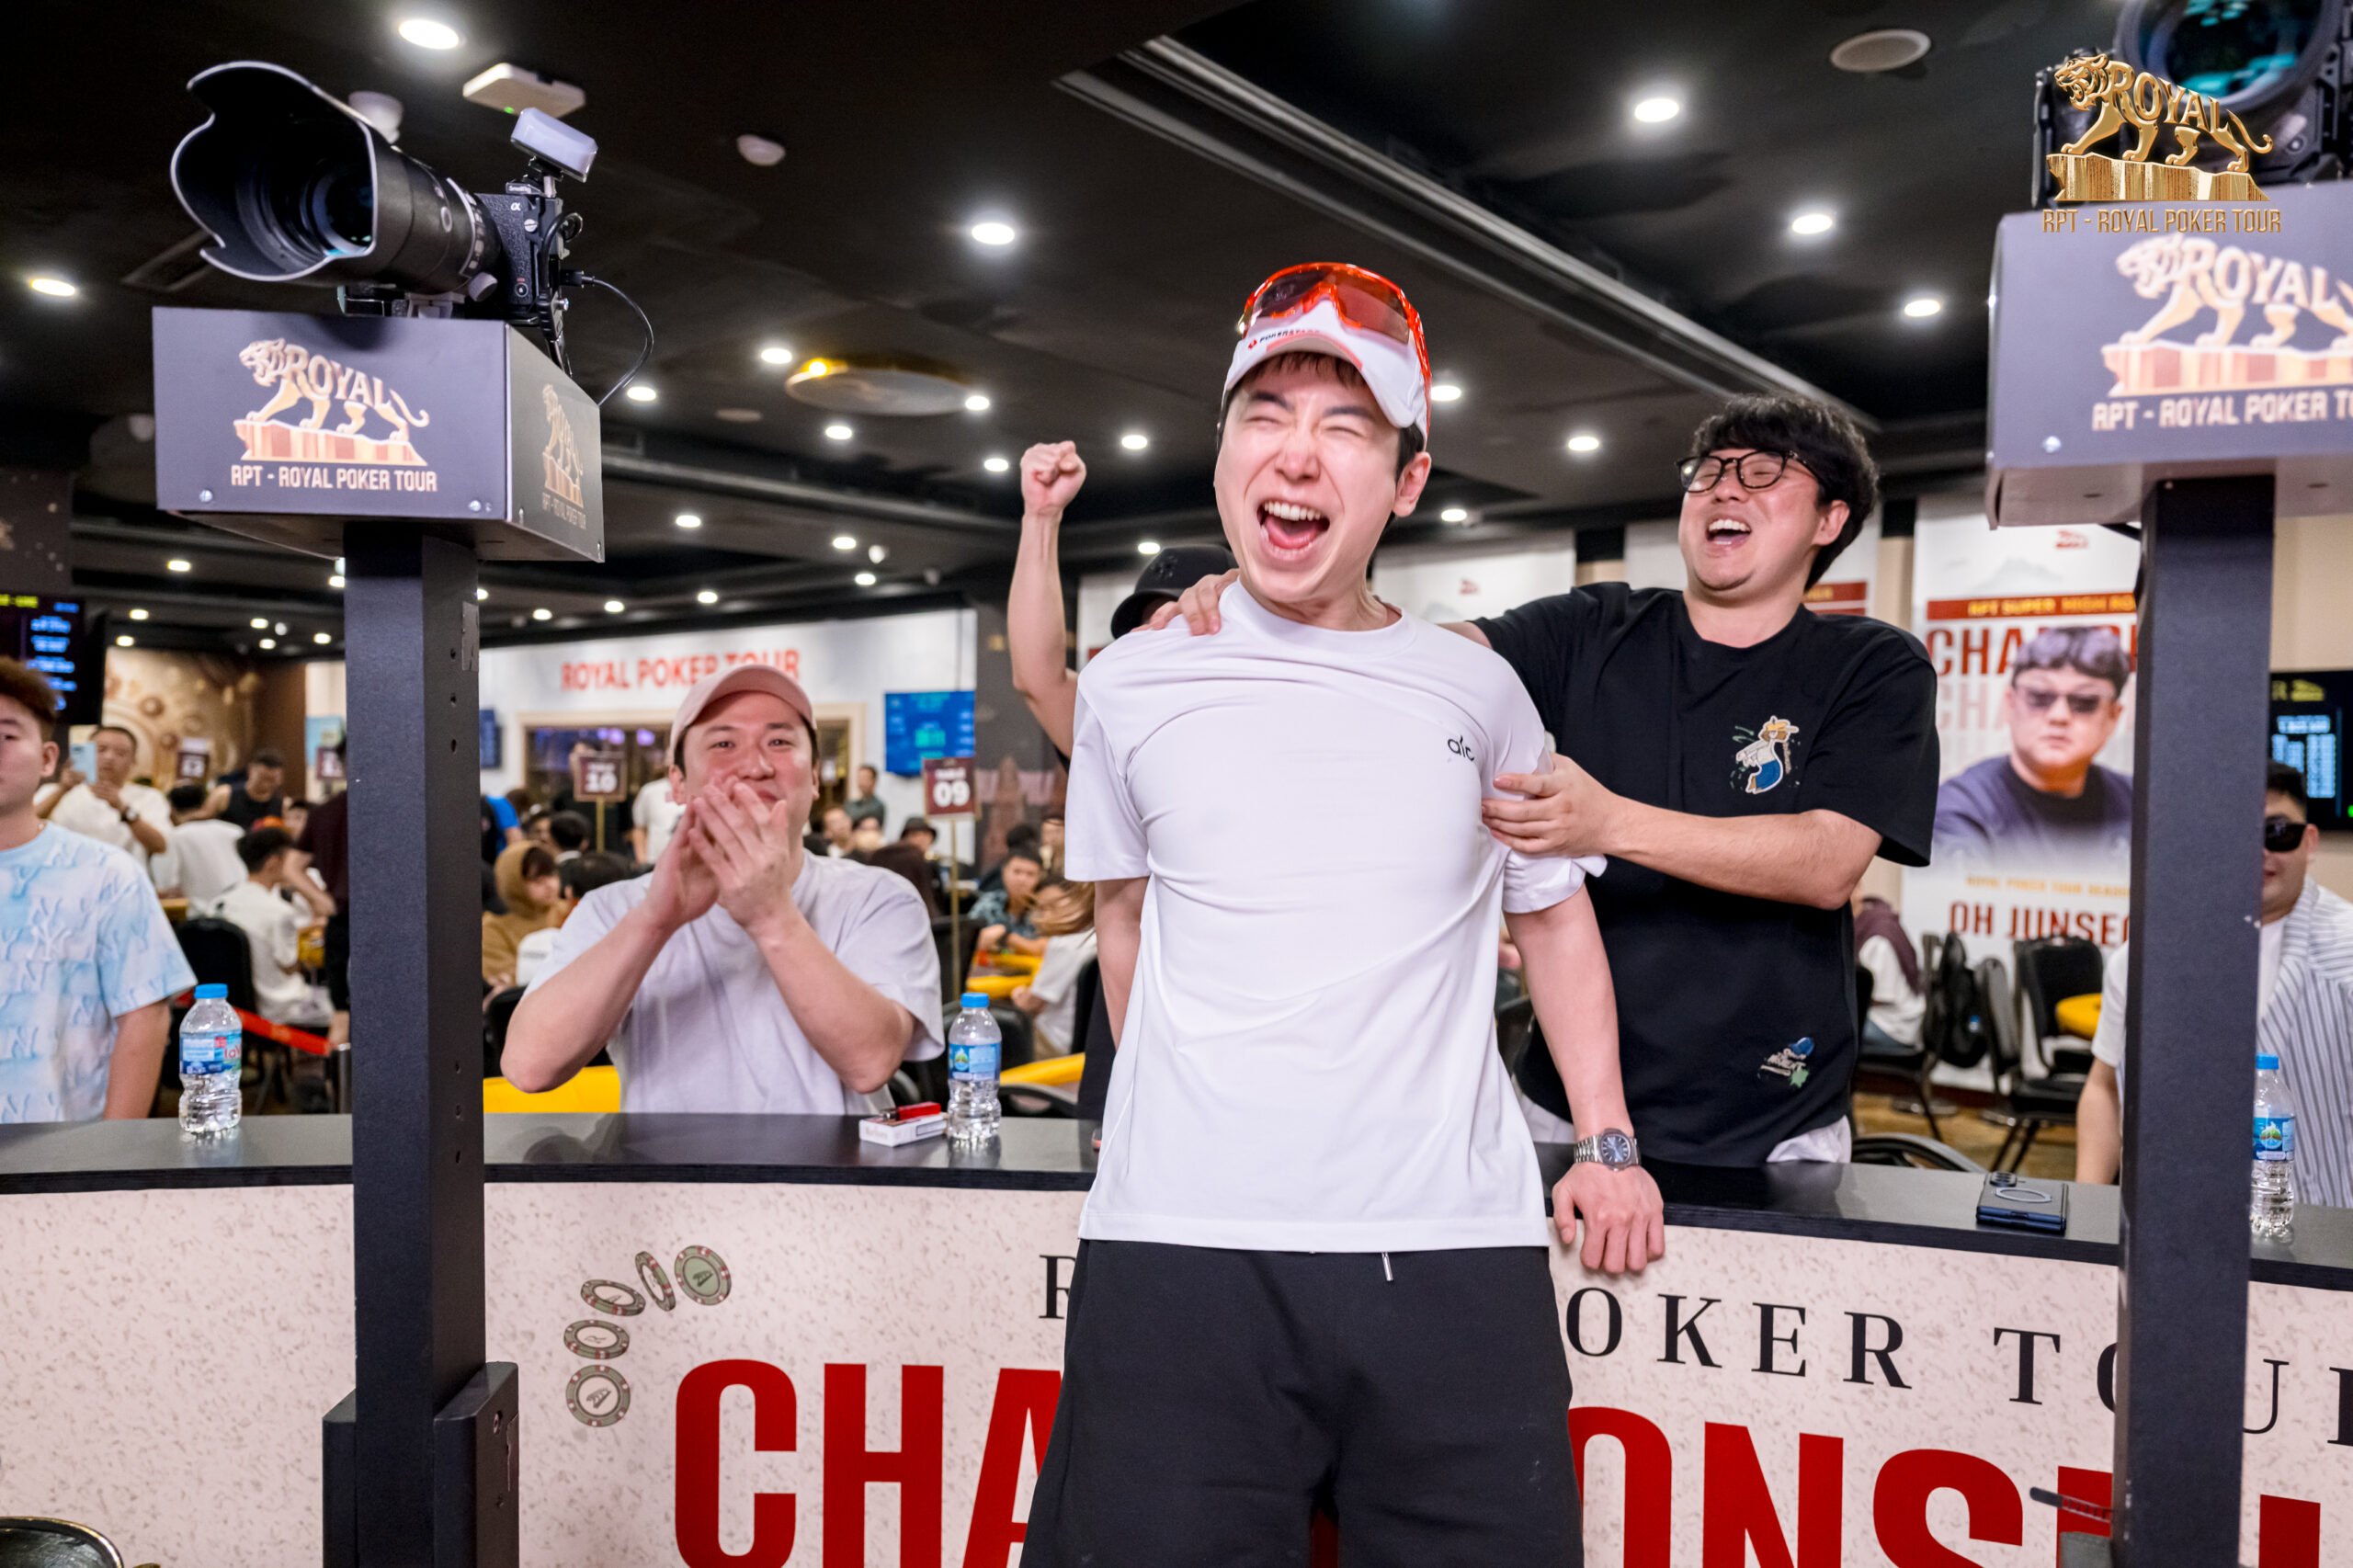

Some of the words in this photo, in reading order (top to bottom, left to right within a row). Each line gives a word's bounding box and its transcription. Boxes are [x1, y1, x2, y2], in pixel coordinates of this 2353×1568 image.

[2180, 237, 2338, 310] ROYAL
[284, 344, 392, 410] ROYAL
[2092, 402, 2139, 431] RPT
[2160, 396, 2239, 428] ROYAL
[2244, 392, 2328, 424] POKER
[231, 464, 263, 487] RPT
[278, 466, 333, 489] ROYAL
[336, 468, 391, 491] POKER
[393, 470, 438, 492] TOUR
[561, 662, 630, 690] ROYAL
[637, 654, 718, 687] POKER
[933, 781, 971, 808] 09
[1950, 902, 1994, 936] OH
[1565, 1286, 1914, 1391] OKER
